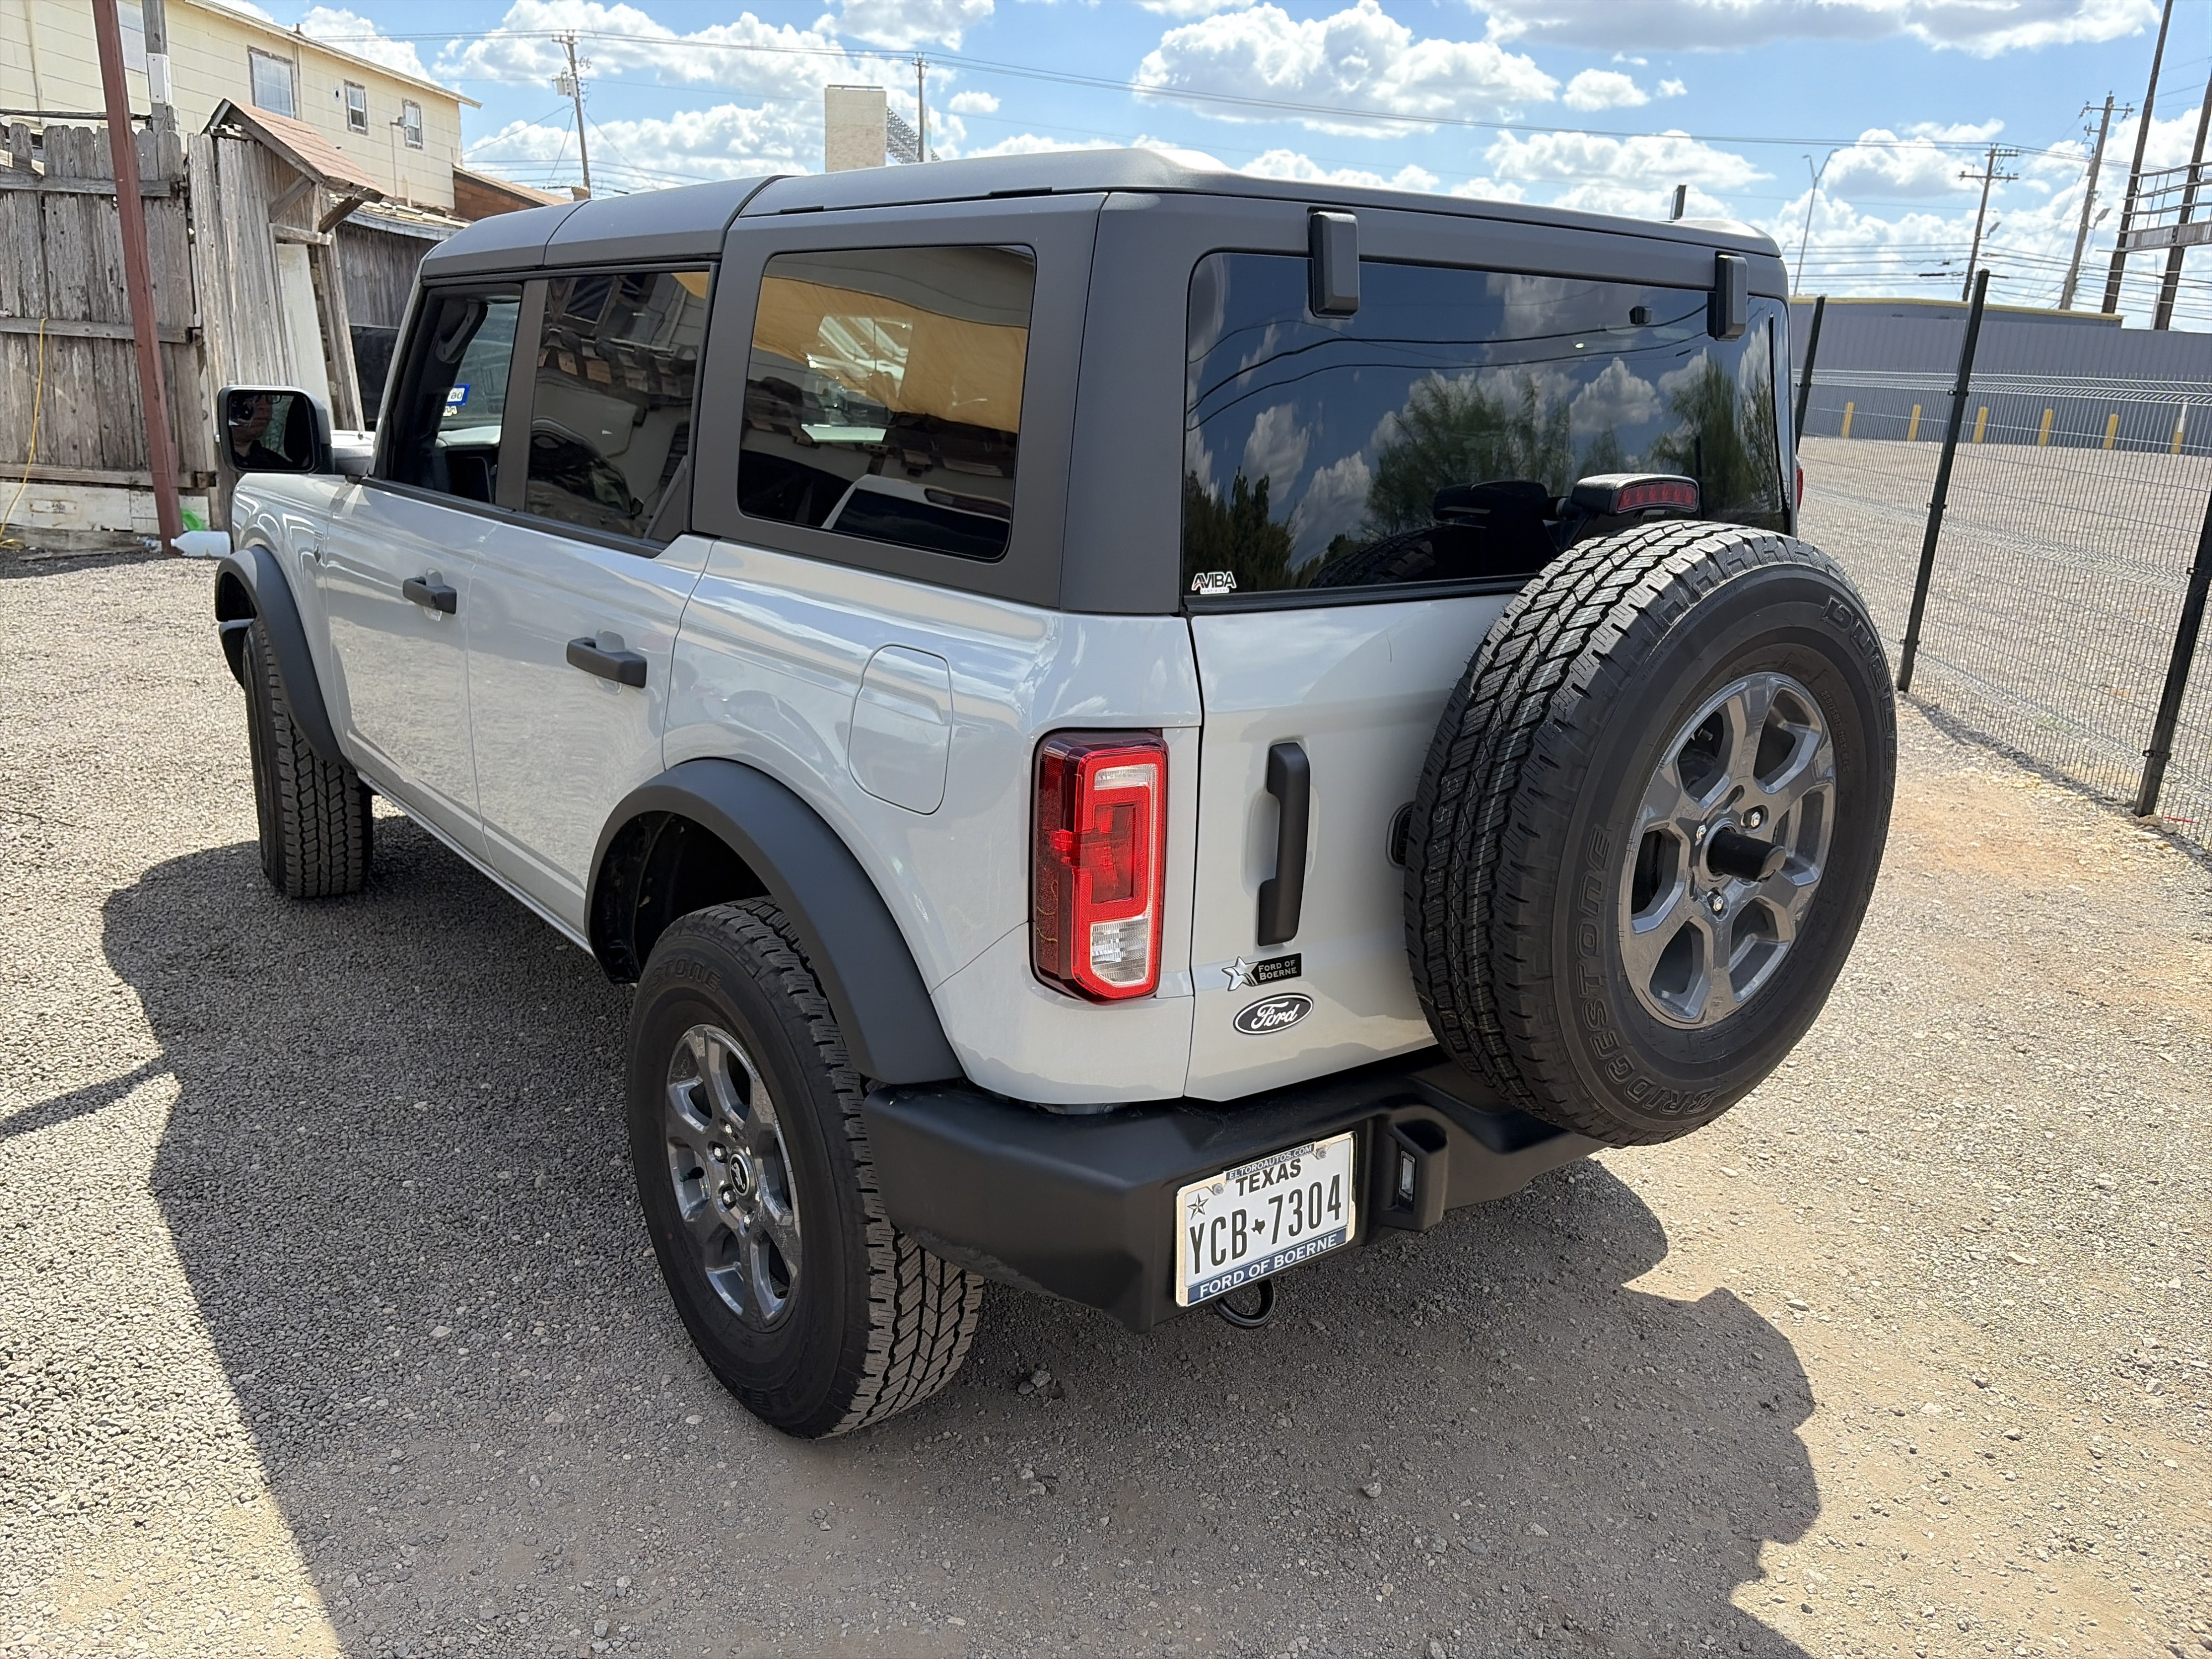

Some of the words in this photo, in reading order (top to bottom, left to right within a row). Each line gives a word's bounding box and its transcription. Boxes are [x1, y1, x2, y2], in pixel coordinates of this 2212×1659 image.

[1192, 572, 1235, 589] AVIBA
[1258, 963, 1282, 973] FORD
[1259, 967, 1297, 980] BOERNE
[1575, 827, 1716, 1115] BRIDGESTONE
[1251, 1001, 1300, 1029] Ford
[1229, 1145, 1312, 1179] ELTOROAUTOS.COM
[1235, 1157, 1302, 1197] TEXAS
[1189, 1209, 1248, 1275] YCB
[1268, 1173, 1342, 1245] 7304
[1199, 1270, 1244, 1298] FORD
[1249, 1260, 1271, 1277] OF
[1274, 1233, 1337, 1267] BOERNE
